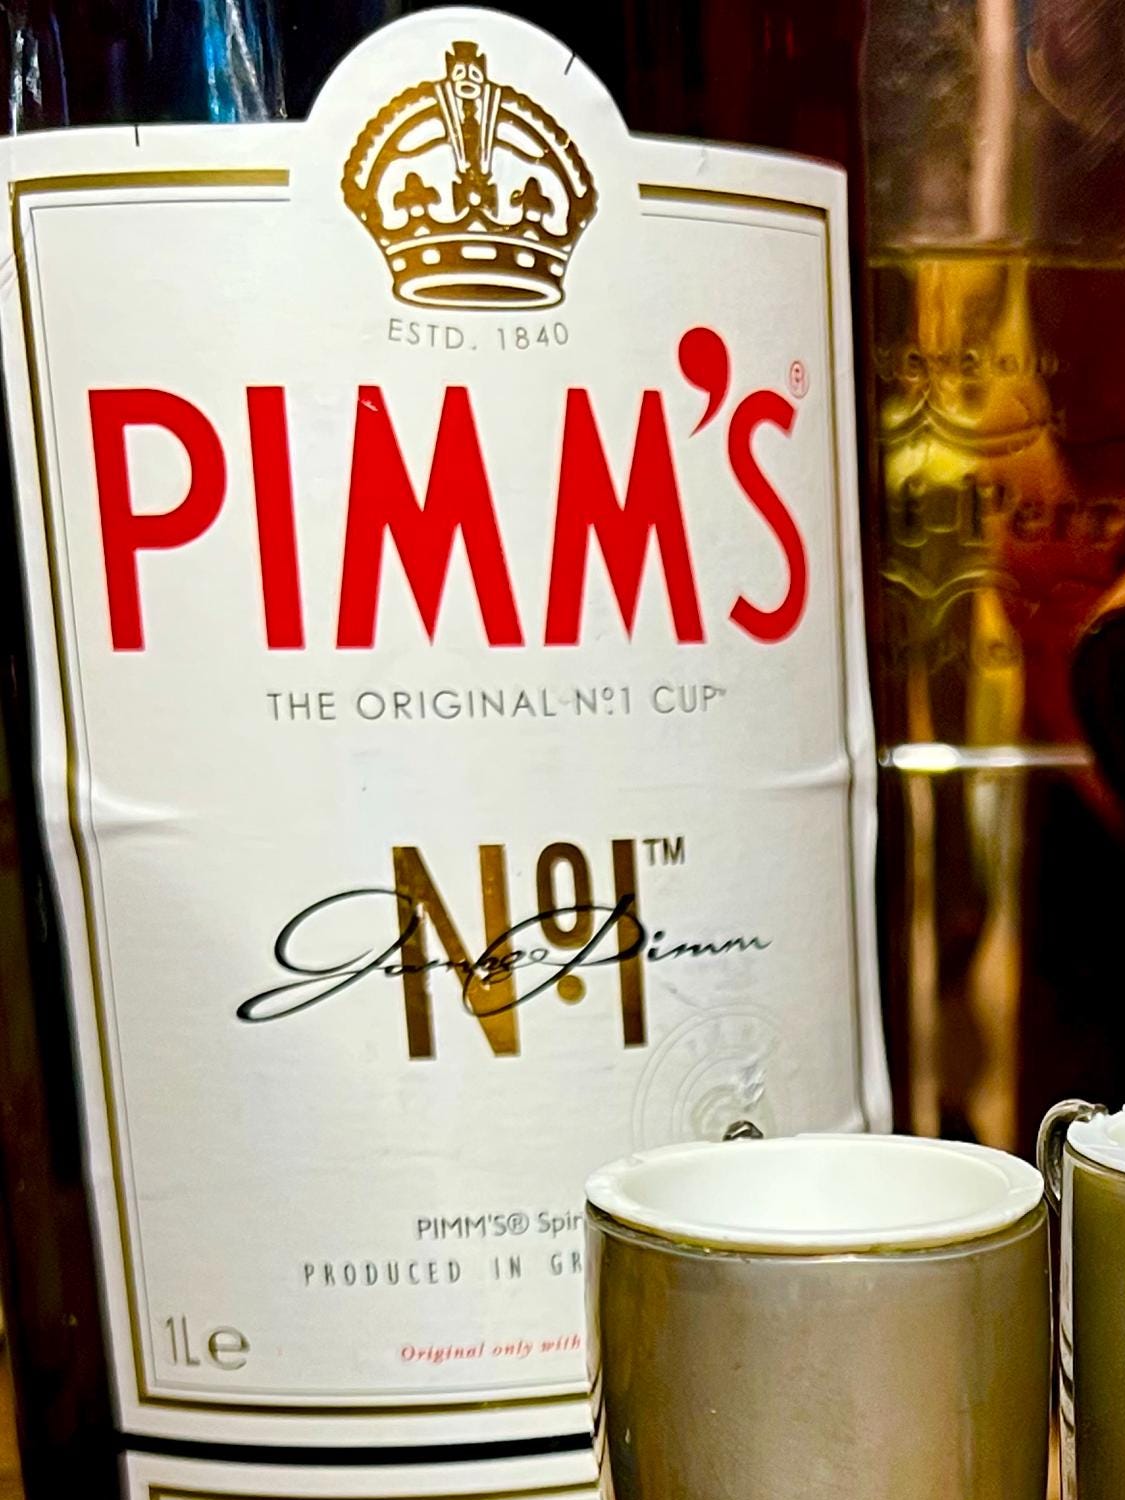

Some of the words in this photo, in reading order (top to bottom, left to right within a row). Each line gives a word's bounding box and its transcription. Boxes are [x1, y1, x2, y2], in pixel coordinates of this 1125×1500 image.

[387, 317, 478, 351] ESTD.
[496, 322, 570, 351] 1840
[267, 692, 337, 721] THE
[355, 688, 558, 721] ORIGINAL
[537, 1208, 583, 1239] Spir
[304, 1260, 463, 1287] PRODUCED
[493, 1255, 522, 1280] IN
[550, 1250, 583, 1277] GR
[400, 1341, 486, 1364] Original
[492, 1339, 535, 1359] only
[540, 1333, 583, 1354] with
